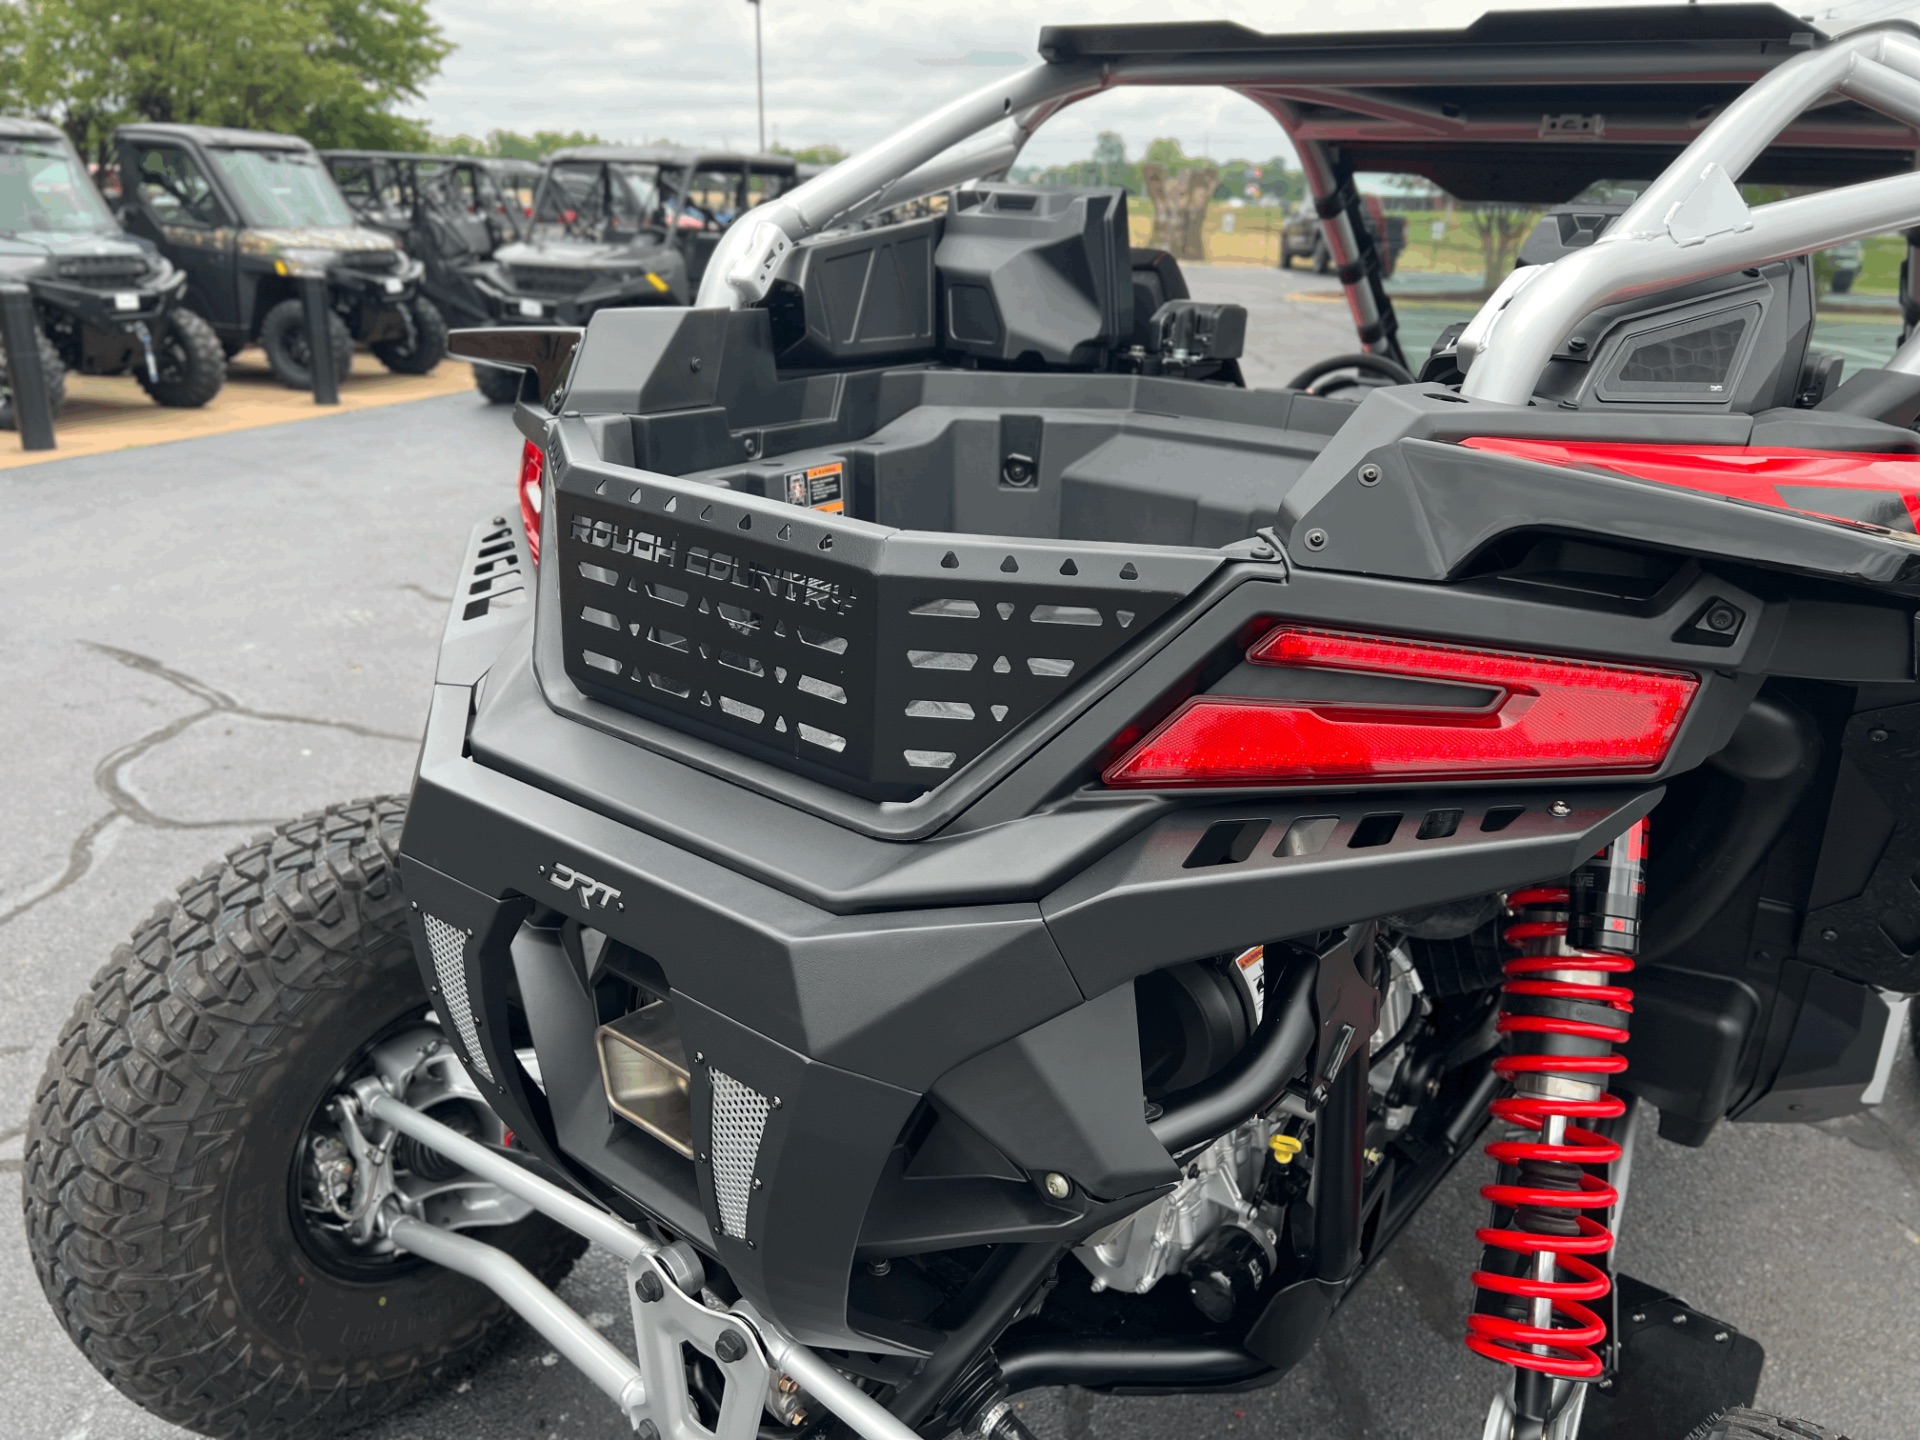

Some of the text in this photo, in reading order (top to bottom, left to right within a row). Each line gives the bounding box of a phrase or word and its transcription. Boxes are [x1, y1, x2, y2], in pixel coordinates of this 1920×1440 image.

[570, 513, 858, 616] ROUGH COUNTRY
[547, 862, 621, 910] DRT
